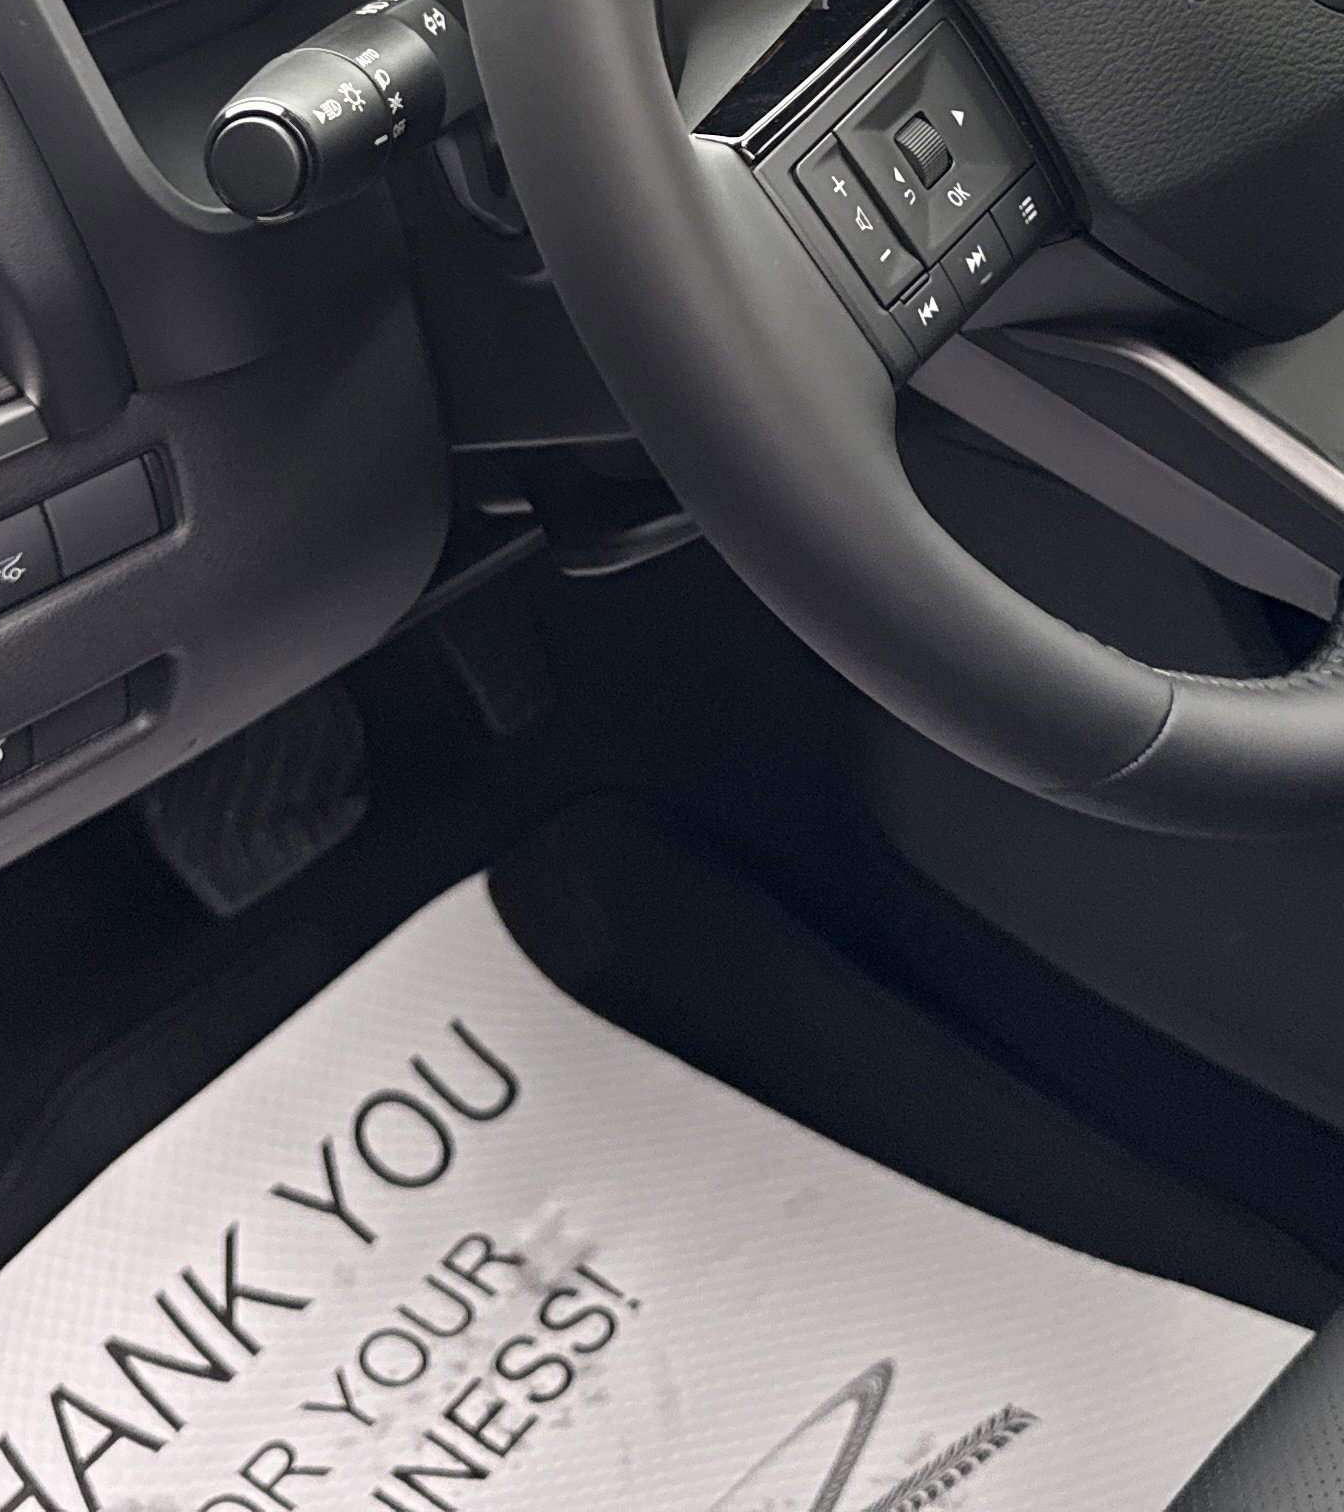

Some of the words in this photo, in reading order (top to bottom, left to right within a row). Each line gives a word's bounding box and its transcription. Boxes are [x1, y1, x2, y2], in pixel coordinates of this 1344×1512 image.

[947, 182, 971, 207] OK
[269, 1016, 522, 1247] YOU
[300, 1232, 526, 1427] YOUR
